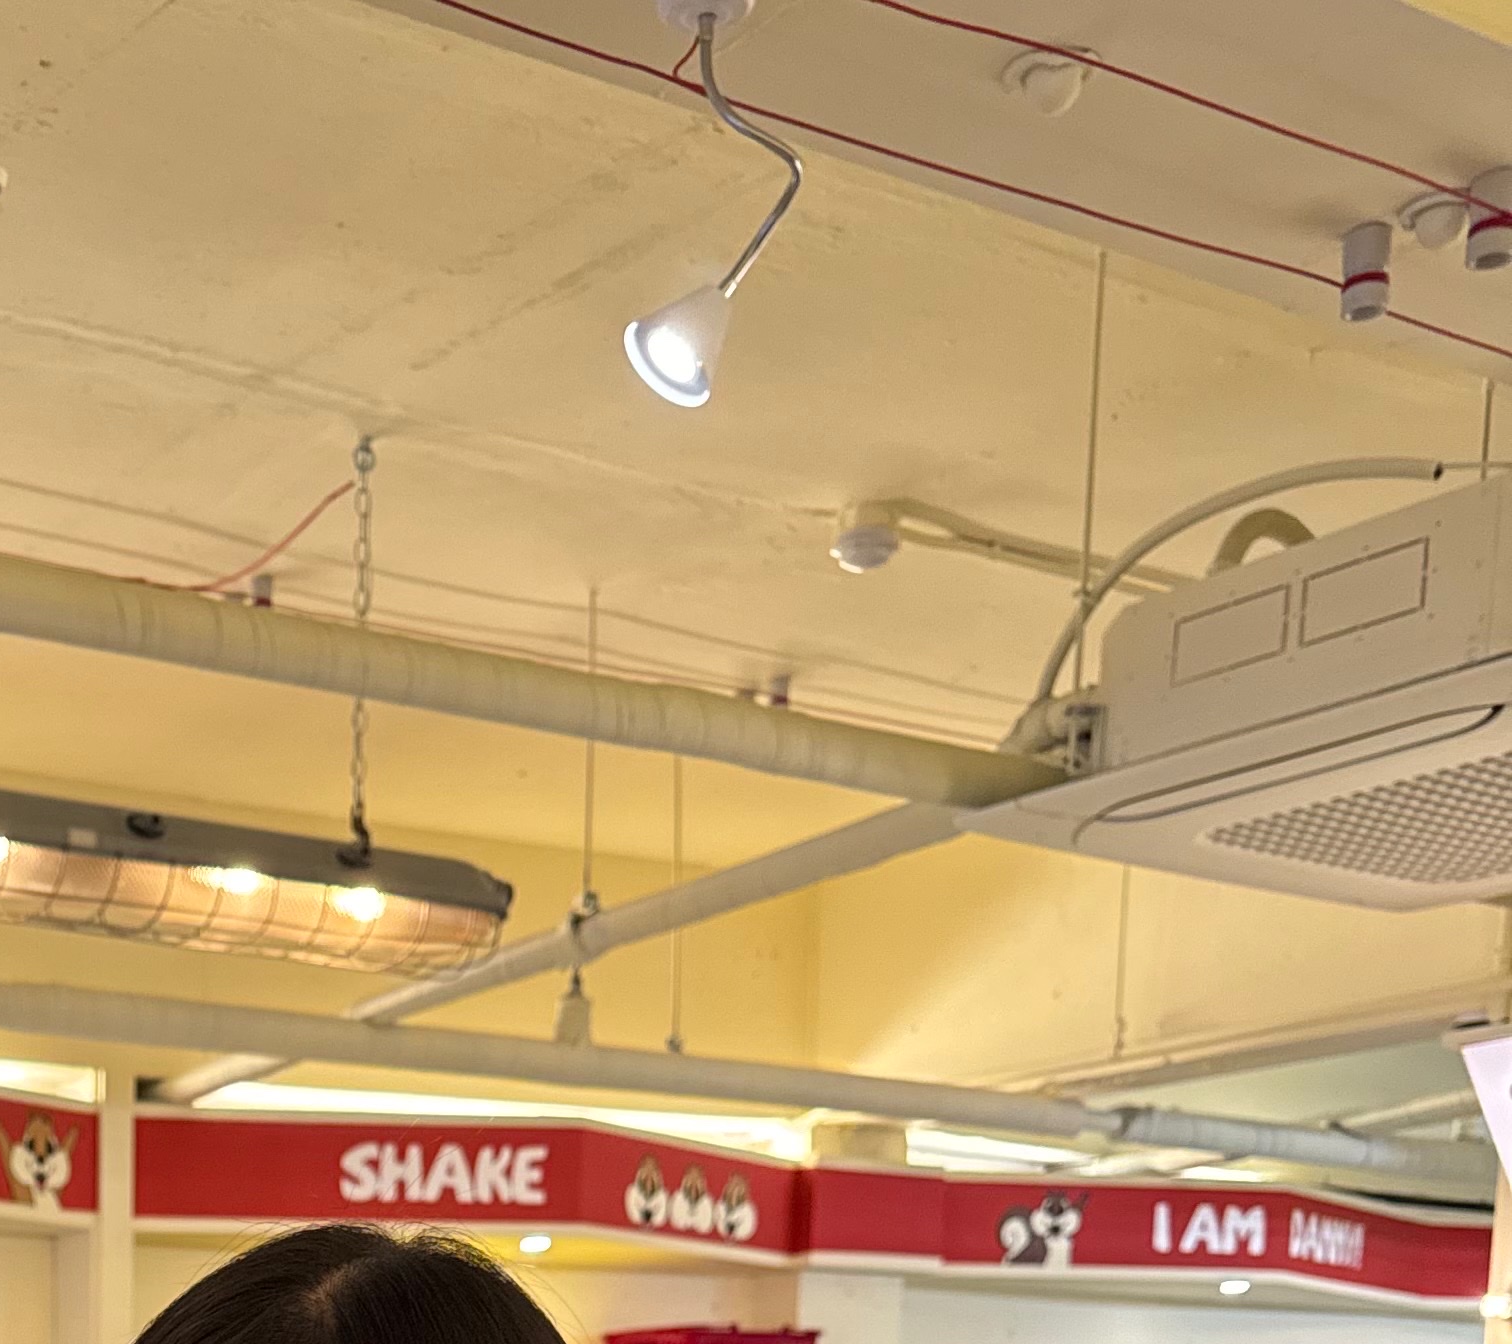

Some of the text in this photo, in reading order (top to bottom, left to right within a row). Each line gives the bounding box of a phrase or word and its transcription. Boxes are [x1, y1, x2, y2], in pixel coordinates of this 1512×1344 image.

[339, 1140, 549, 1206] SHAKE
[1151, 1201, 1172, 1254] I
[1178, 1202, 1266, 1256] AM
